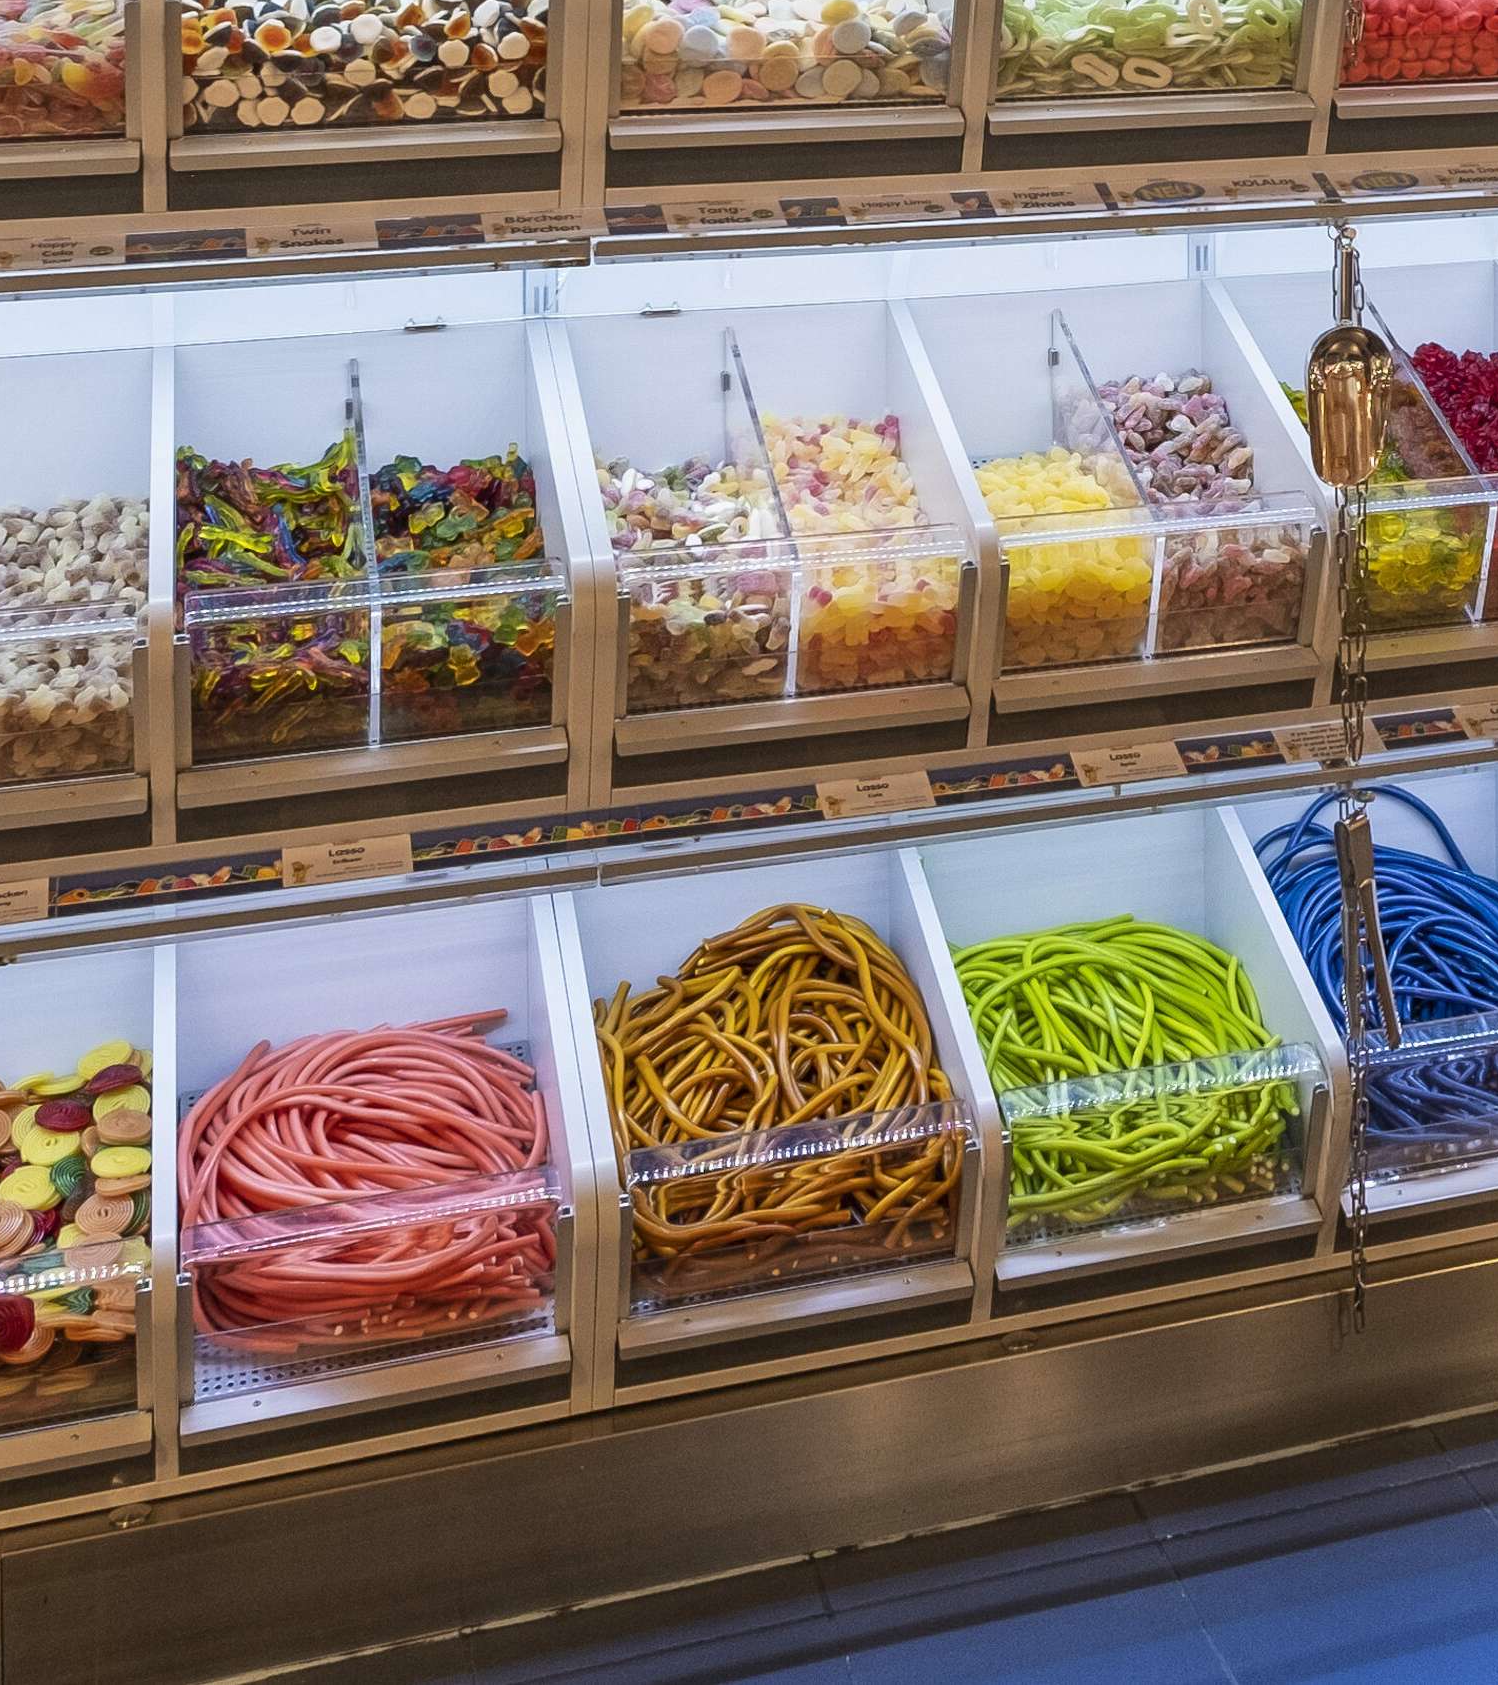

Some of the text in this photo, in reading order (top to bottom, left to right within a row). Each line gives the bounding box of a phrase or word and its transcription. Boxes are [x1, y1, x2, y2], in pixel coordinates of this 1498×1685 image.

[1013, 190, 1072, 200] Ingwer-
[1022, 200, 1076, 210] Zitrone
[698, 206, 746, 216] Tang-
[504, 213, 582, 225] Bärchen-
[291, 226, 331, 236] Twin
[511, 223, 581, 235] Pärchen
[31, 240, 79, 250] Happy
[279, 236, 345, 249] Snakes
[42, 249, 74, 257] Cola
[1109, 752, 1141, 761] Lasso
[856, 782, 890, 793] Lasso
[328, 845, 365, 857] Lasso
